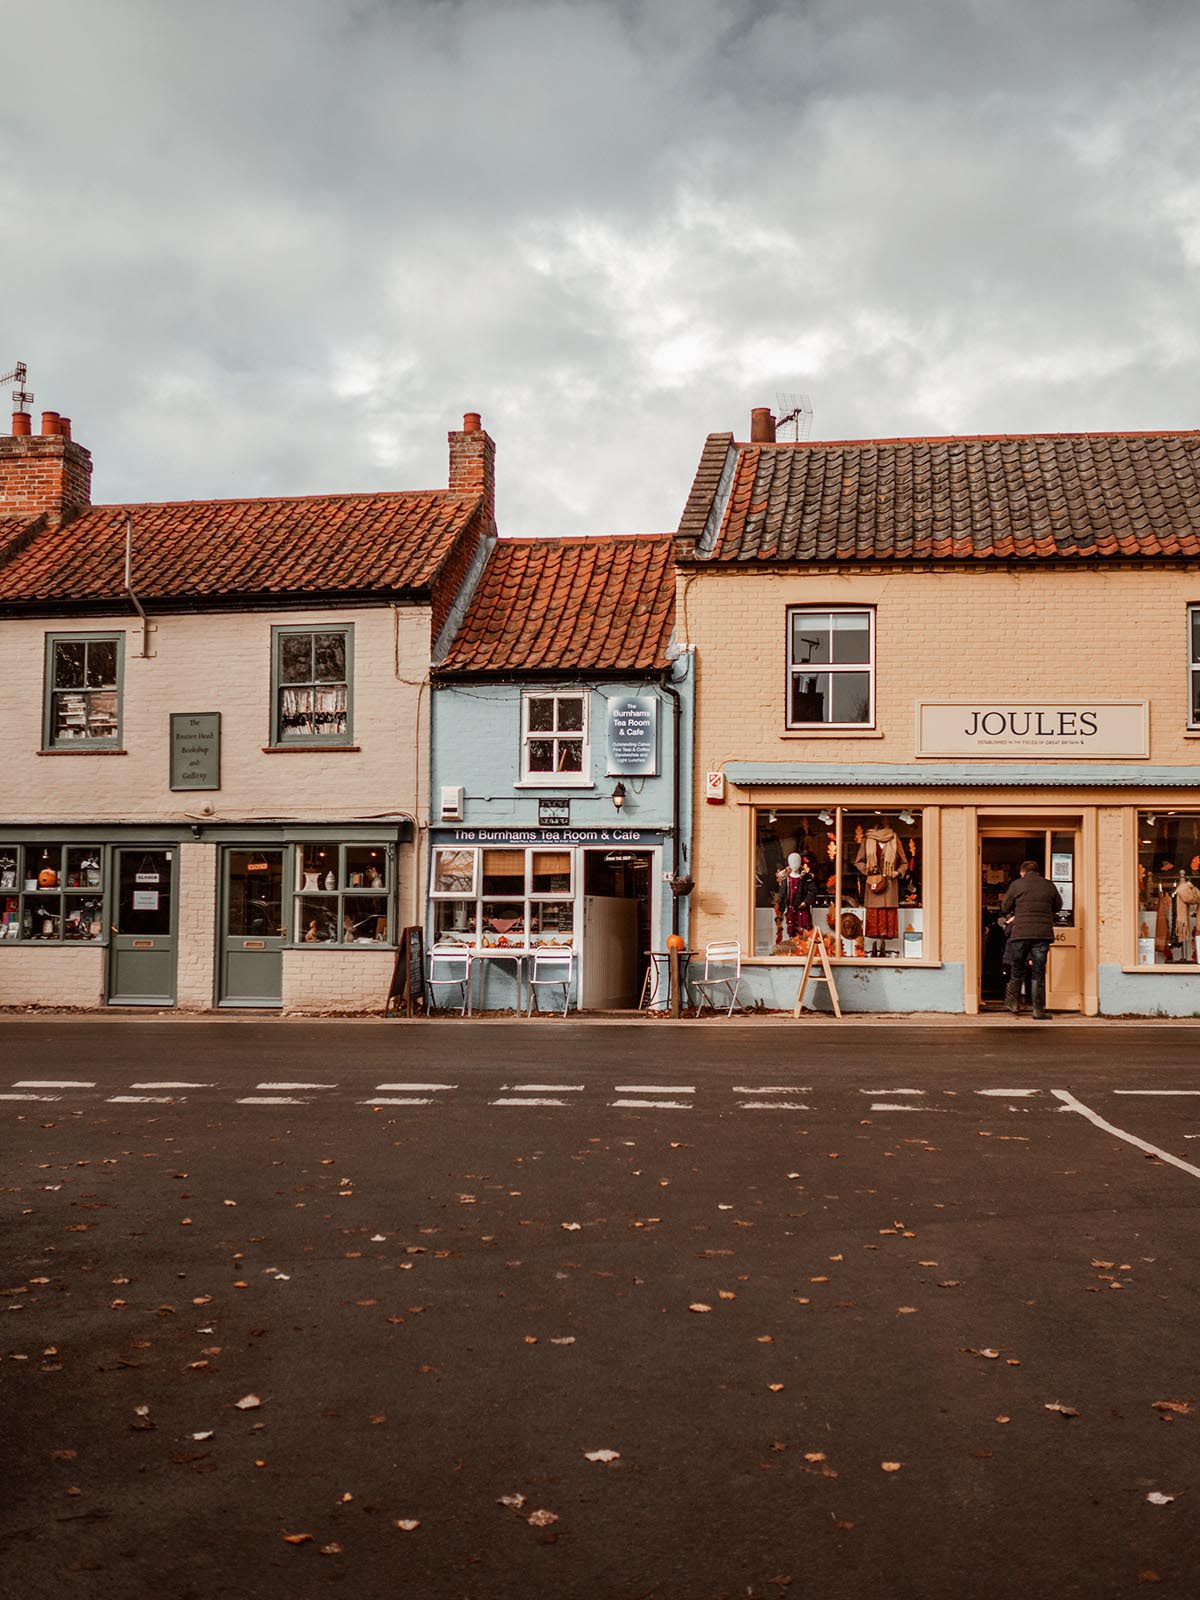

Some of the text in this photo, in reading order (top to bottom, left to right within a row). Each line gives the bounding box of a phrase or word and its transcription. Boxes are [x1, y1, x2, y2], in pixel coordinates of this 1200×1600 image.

[613, 719, 650, 727] Tea Room
[964, 711, 1098, 736] JOULES
[619, 728, 644, 736] & Cafe
[454, 829, 640, 840] The Burnhams Tea Room & Cafe
[1055, 933, 1066, 942] 46
